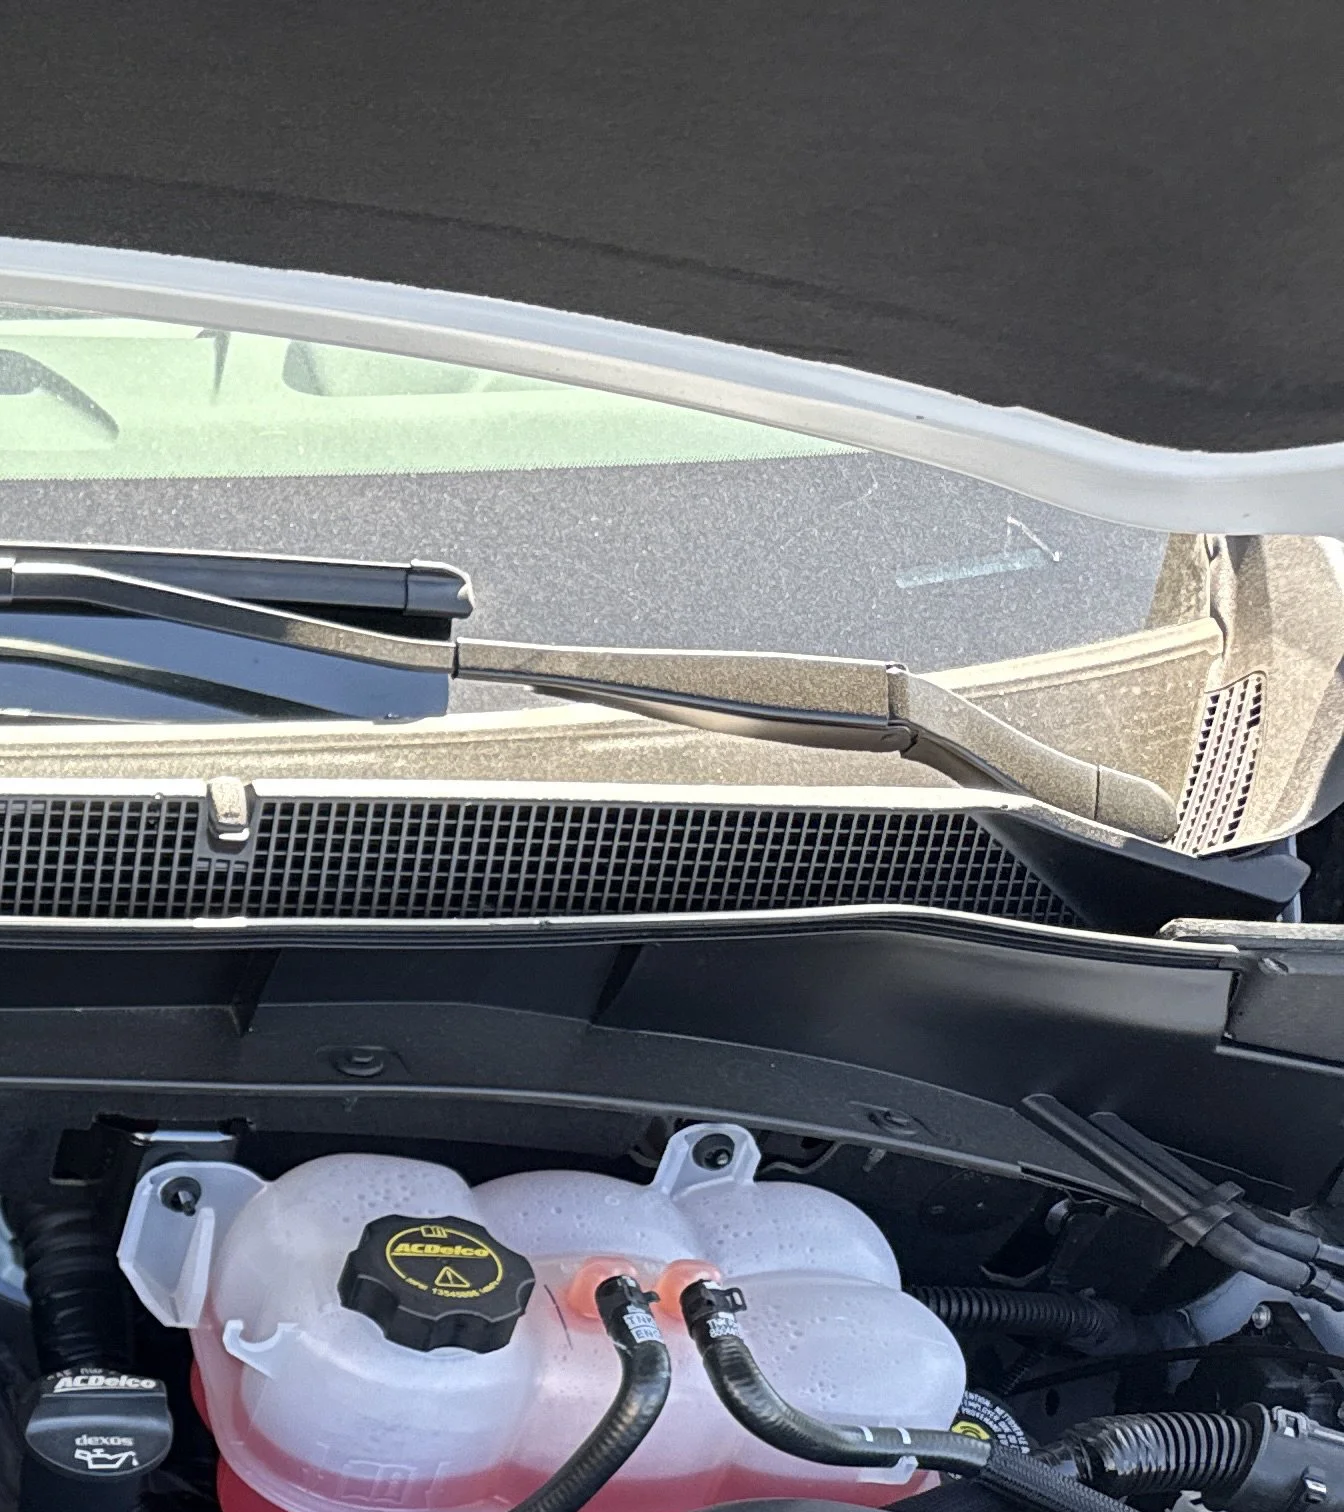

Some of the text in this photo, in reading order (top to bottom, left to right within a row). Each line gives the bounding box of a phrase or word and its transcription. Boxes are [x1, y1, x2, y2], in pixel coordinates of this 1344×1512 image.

[393, 1243, 489, 1257] ACDelco
[54, 1375, 156, 1391] ACDelco
[75, 1434, 134, 1446] dexos
